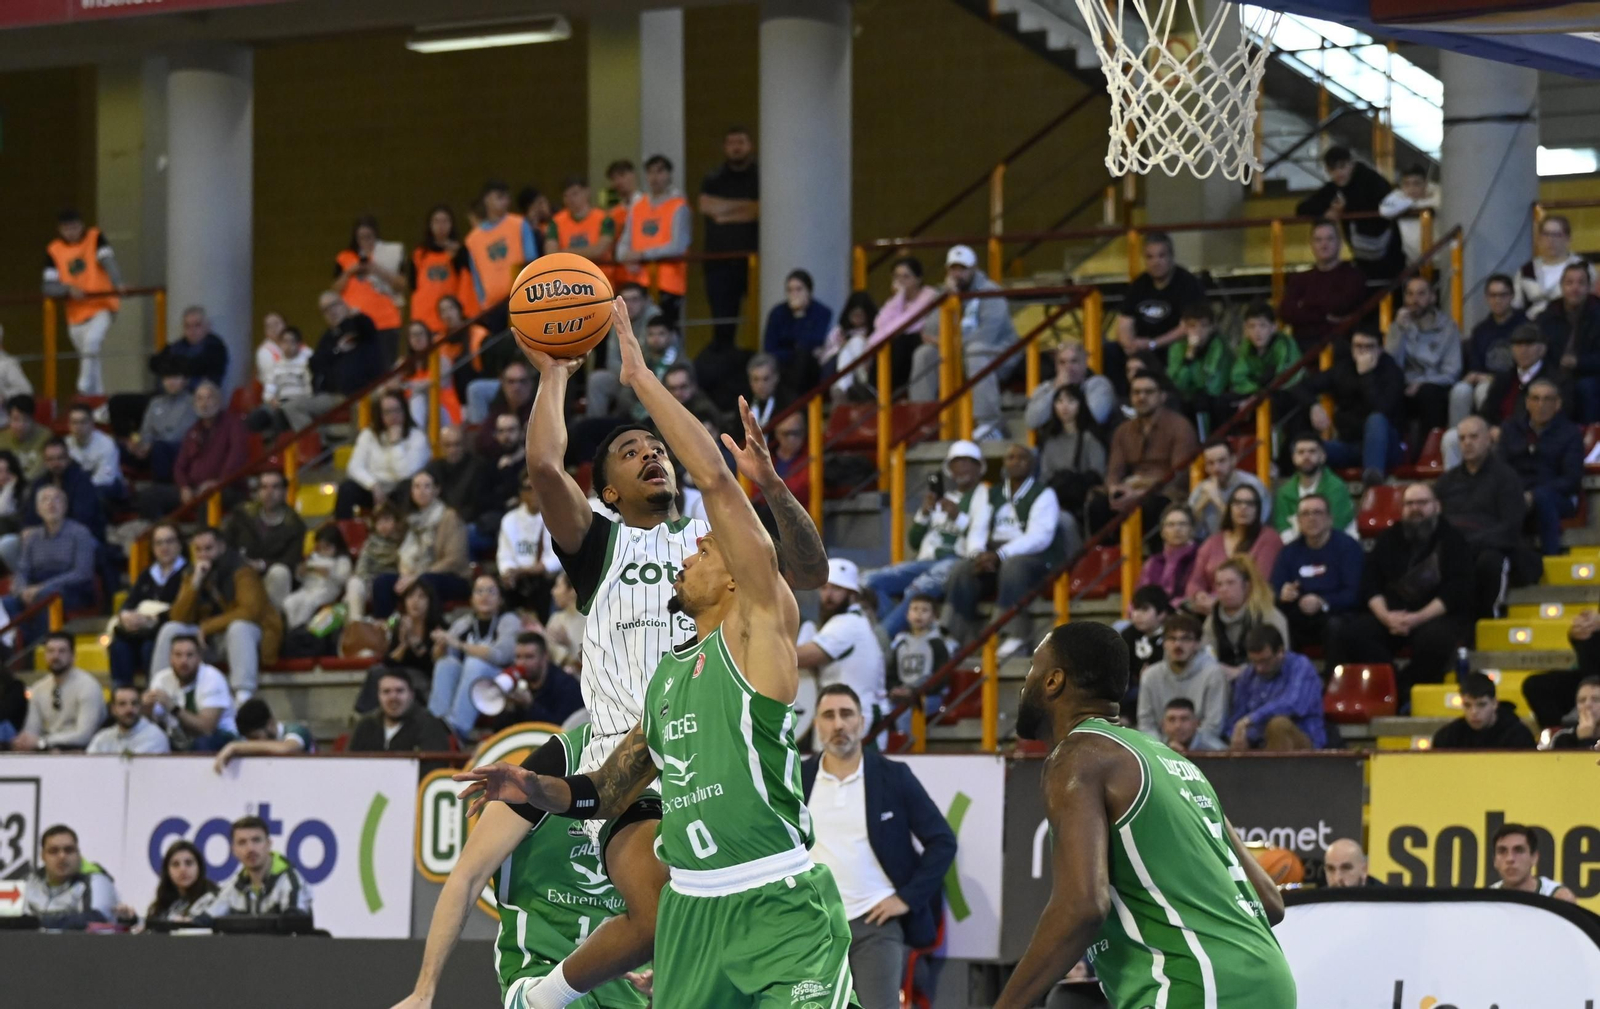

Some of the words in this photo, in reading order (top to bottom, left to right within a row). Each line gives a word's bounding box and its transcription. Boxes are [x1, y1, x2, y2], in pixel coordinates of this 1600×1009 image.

[524, 279, 596, 303] Wilson
[543, 317, 584, 335] EVO
[619, 561, 679, 585] cot
[616, 618, 667, 631] Fundación
[676, 615, 697, 632] Ca
[685, 819, 718, 860] 0
